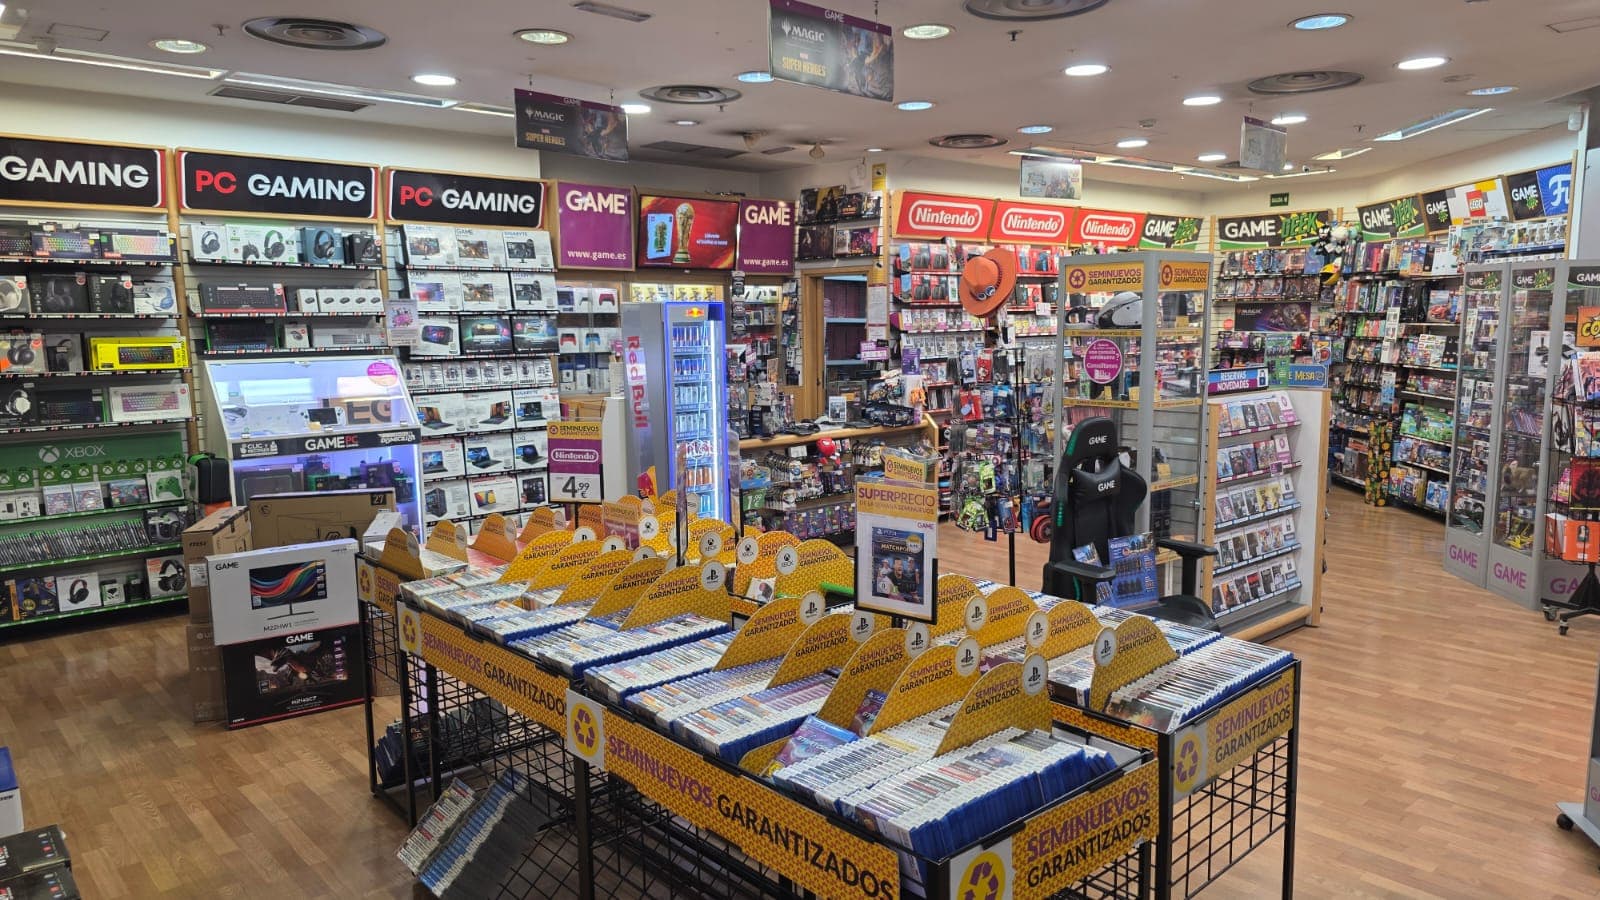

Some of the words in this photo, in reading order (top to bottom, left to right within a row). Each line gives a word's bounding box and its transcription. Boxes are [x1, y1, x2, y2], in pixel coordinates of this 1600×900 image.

[825, 10, 844, 22] GAME
[792, 25, 824, 42] MAGIC
[782, 56, 801, 71] SUPER
[534, 110, 564, 121] MAGIC
[0, 156, 149, 188] GAMING
[195, 170, 236, 193] PC
[248, 174, 365, 202] GAMING
[1511, 184, 1539, 201] GAME
[400, 185, 433, 207] PC
[441, 189, 535, 213] GAMING
[566, 190, 626, 215] GAME
[1426, 200, 1449, 214] GAME
[1470, 199, 1483, 211] LEGO
[745, 205, 790, 226] GAME
[916, 207, 976, 227] Nintendo
[1007, 214, 1058, 231] Nintendo
[1363, 208, 1393, 228] GAME
[1085, 221, 1130, 236] Nintendo
[1145, 220, 1176, 238] GAME
[1225, 220, 1277, 238] GAME
[567, 249, 627, 261] www.game.es
[744, 257, 788, 267] www.game.es
[1087, 277, 1141, 286] GARANTIZADOS
[1088, 268, 1142, 279] SEMINUEVOS
[1173, 276, 1207, 284] GARANTIZADOS
[1174, 268, 1207, 279] SEMINUEVOS
[1469, 277, 1484, 286] GAME
[1516, 276, 1534, 285] GAME
[627, 335, 644, 381] Red
[1220, 370, 1247, 381] RESERVAS
[1217, 380, 1249, 392] NOVEDADES
[631, 385, 649, 428] Bull
[559, 425, 600, 433] SEMINUEVOS
[1088, 436, 1107, 446] GAME
[64, 445, 106, 458] XBOX
[555, 450, 596, 460] Nintendo
[1098, 479, 1115, 492] GAME
[858, 487, 936, 507] SUPERPRECIO
[559, 550, 600, 563] SEMINUEVOS
[1449, 544, 1478, 569] GAME
[215, 561, 239, 572] GAME
[590, 559, 630, 573] SEMINUEVOS
[613, 575, 660, 591] GARANTIZADO
[622, 568, 664, 583] SEMINUEVOS
[657, 575, 698, 591] SEMINUEVOS
[1493, 562, 1528, 589] GAME
[378, 577, 400, 595] SEMIN
[648, 582, 700, 600] GARANTIZADOS
[937, 583, 968, 598] EMINUEVOS
[1550, 577, 1580, 595] GA
[937, 590, 976, 606] ARANTIZADOS
[988, 599, 1023, 615] SEMINUEVOS
[754, 608, 797, 626] SEMINUEVOS
[988, 604, 1030, 623] GARANTIZADOS
[1050, 611, 1083, 628] SEMINUEVOS
[744, 616, 798, 637] GARANTIZADOS
[1050, 616, 1091, 637] GARANTIZADOS
[1118, 627, 1151, 643] SEMINUEVOS
[286, 632, 314, 644] GAME
[805, 627, 848, 645] SEMINUEVOS
[1118, 632, 1158, 654] GARANTIZADOS
[423, 630, 482, 674] SEMINUEVOS
[795, 636, 849, 658] GARANTIZADOS
[859, 643, 903, 663] SEMINUEVOS
[850, 651, 904, 677] GARANTIZADOS
[909, 657, 953, 680] SEMINUEVOS
[900, 668, 954, 694] GARANTIZADOS
[975, 677, 1020, 700] SEMINUEVOS
[965, 687, 1021, 715] GARANTIZADOS
[1214, 682, 1290, 744] SEMINUEVOS
[1214, 704, 1291, 764] GARANTIZADOS
[608, 734, 714, 809] SEMINUEVOS
[1027, 781, 1149, 863] SEMINUEVOS
[717, 792, 894, 900] GARANTIZADOS
[1027, 811, 1151, 888] GARANTIZADOS
